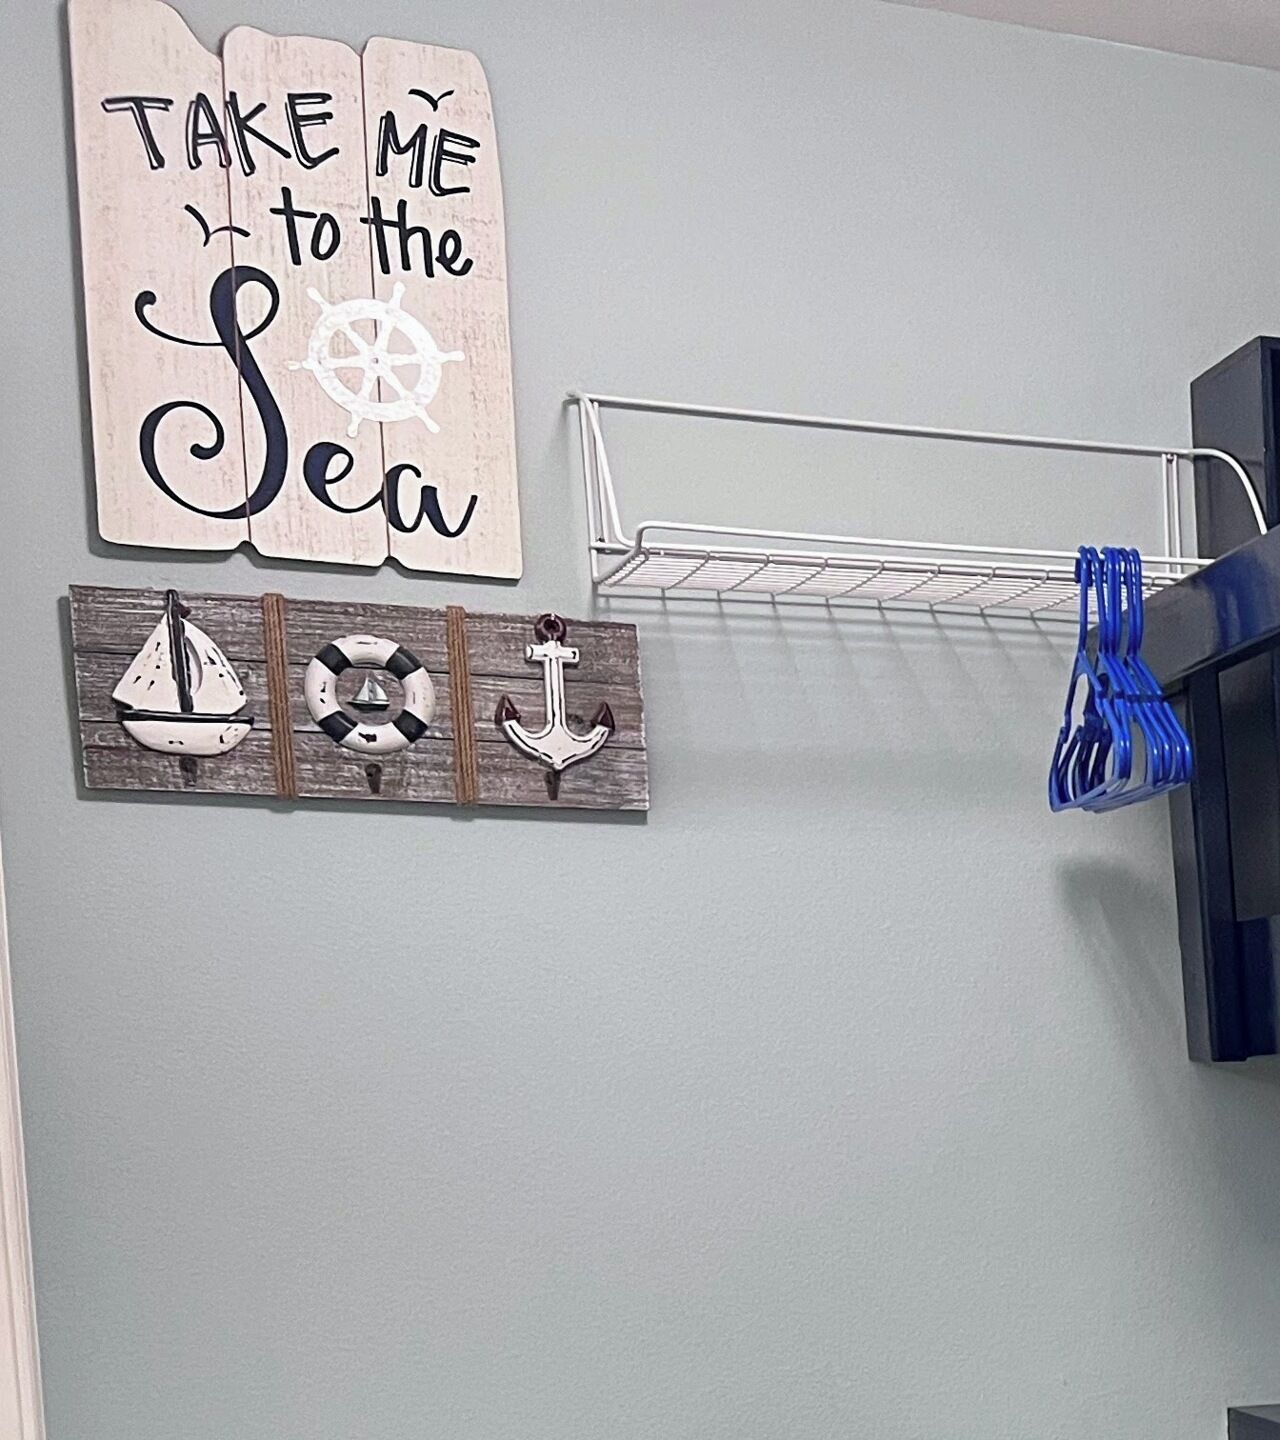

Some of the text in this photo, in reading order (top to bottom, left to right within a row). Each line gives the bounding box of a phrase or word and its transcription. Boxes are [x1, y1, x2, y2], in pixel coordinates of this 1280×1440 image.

[101, 92, 480, 197] TAKE ME
[271, 187, 473, 278] to the
[135, 265, 478, 539] Sea
